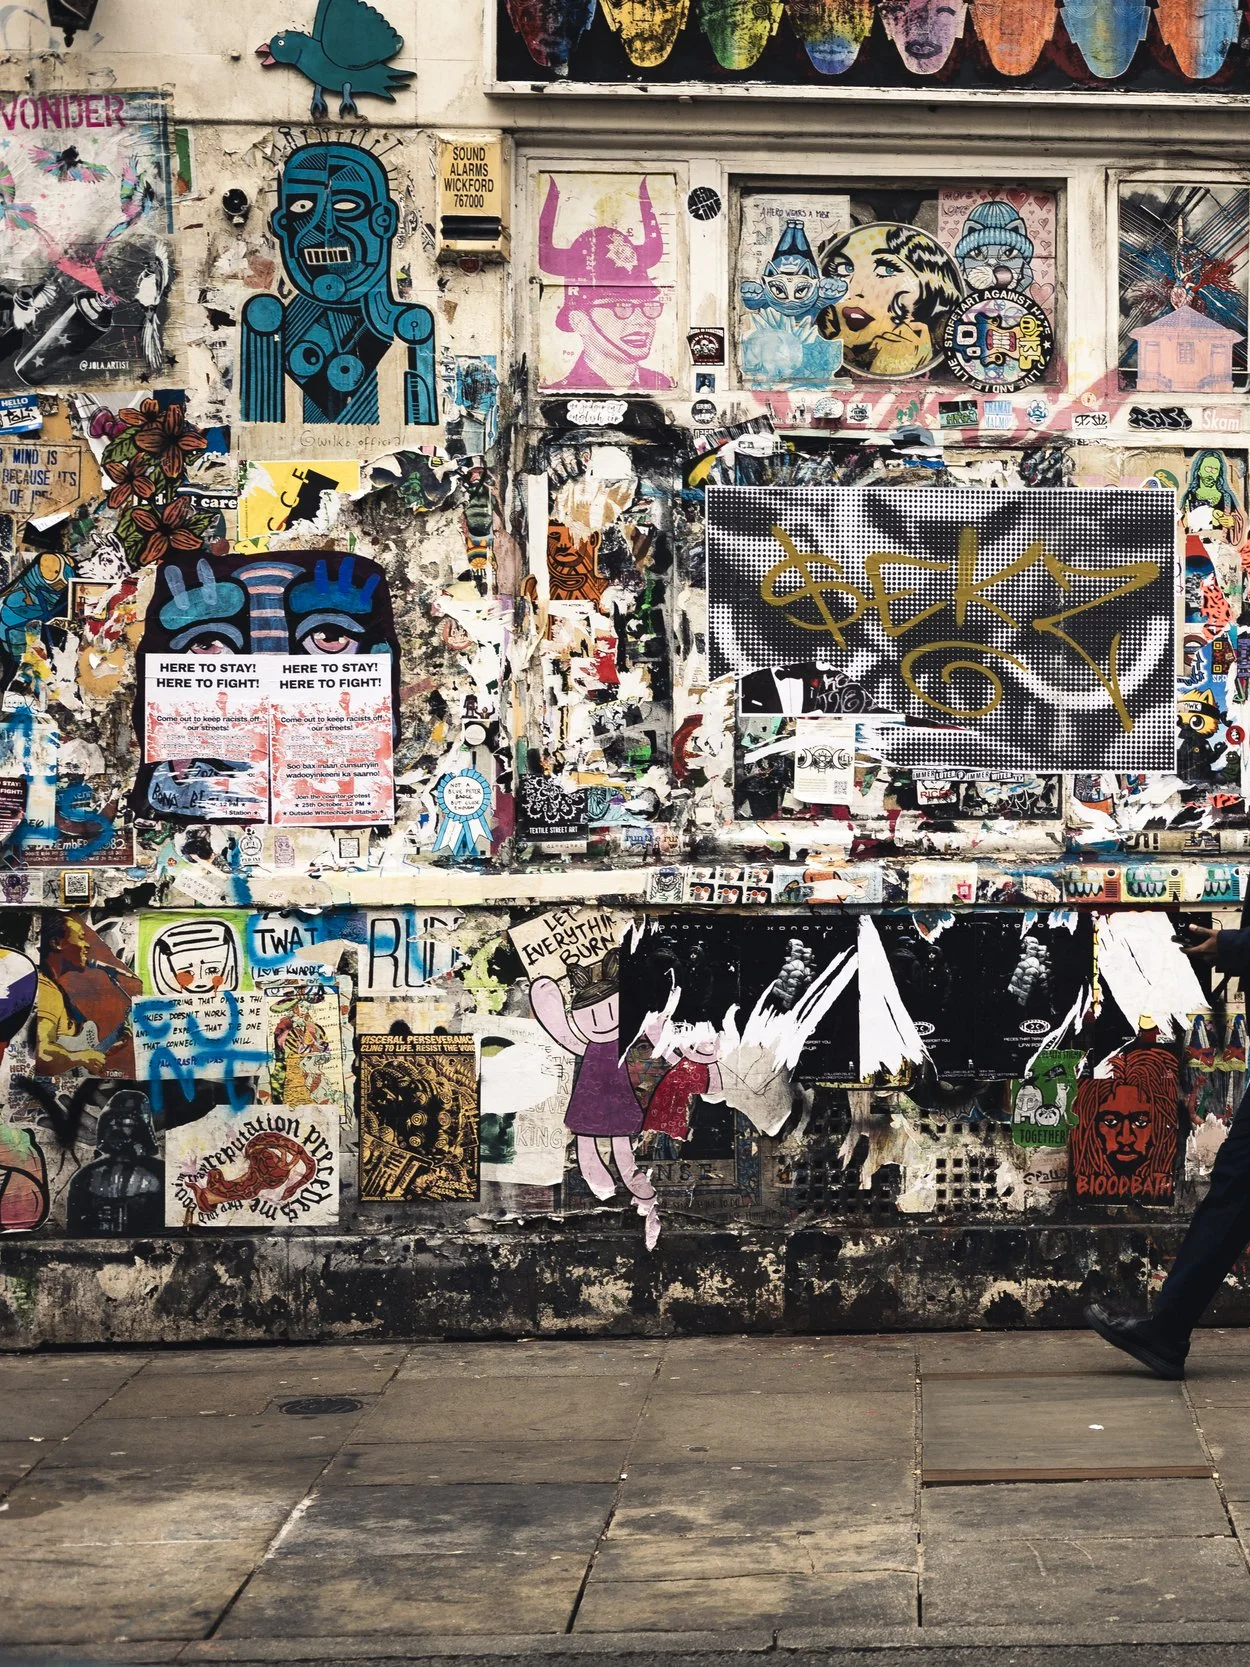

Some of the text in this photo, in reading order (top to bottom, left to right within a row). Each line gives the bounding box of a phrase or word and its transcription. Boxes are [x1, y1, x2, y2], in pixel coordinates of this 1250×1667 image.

[453, 147, 486, 161] SOUND
[450, 164, 489, 178] ALARMS
[444, 178, 494, 194] WICKFORD
[454, 194, 485, 208] 767000
[945, 290, 1032, 347] STREETART AGAINST
[993, 383, 1015, 393] AND
[1, 397, 29, 407] HELLO
[1202, 408, 1240, 431] Skam
[13, 448, 59, 465] MIND IS
[3, 468, 50, 486] BECAUSE
[10, 488, 24, 505] OF
[202, 498, 238, 510] care
[160, 663, 257, 674] HERE TO STAY!
[283, 662, 378, 675] HERE TO STAY!
[157, 678, 260, 688] HERE TO FIGHT!
[280, 678, 382, 689] HERE TO FIGHT!
[202, 715, 221, 724] keep
[326, 715, 345, 724] keep
[373, 714, 383, 722] off
[201, 724, 229, 732] streets!
[325, 724, 353, 732] streets!
[356, 808, 378, 816] Station
[543, 909, 577, 931] LET
[253, 928, 318, 956] TWAT
[559, 932, 616, 966] BURN
[199, 997, 217, 1005] THAT
[205, 1009, 227, 1018] WORK
[248, 1007, 261, 1016] ME
[205, 1022, 262, 1032] THAT ONE
[361, 1035, 403, 1044] VISCERAL
[142, 1043, 161, 1051] THAT
[361, 1044, 384, 1052] CLING
[385, 1044, 394, 1052] TO
[416, 1044, 442, 1052] RESIST
[444, 1044, 458, 1052] THE
[1019, 1130, 1066, 1144] TOGETHER
